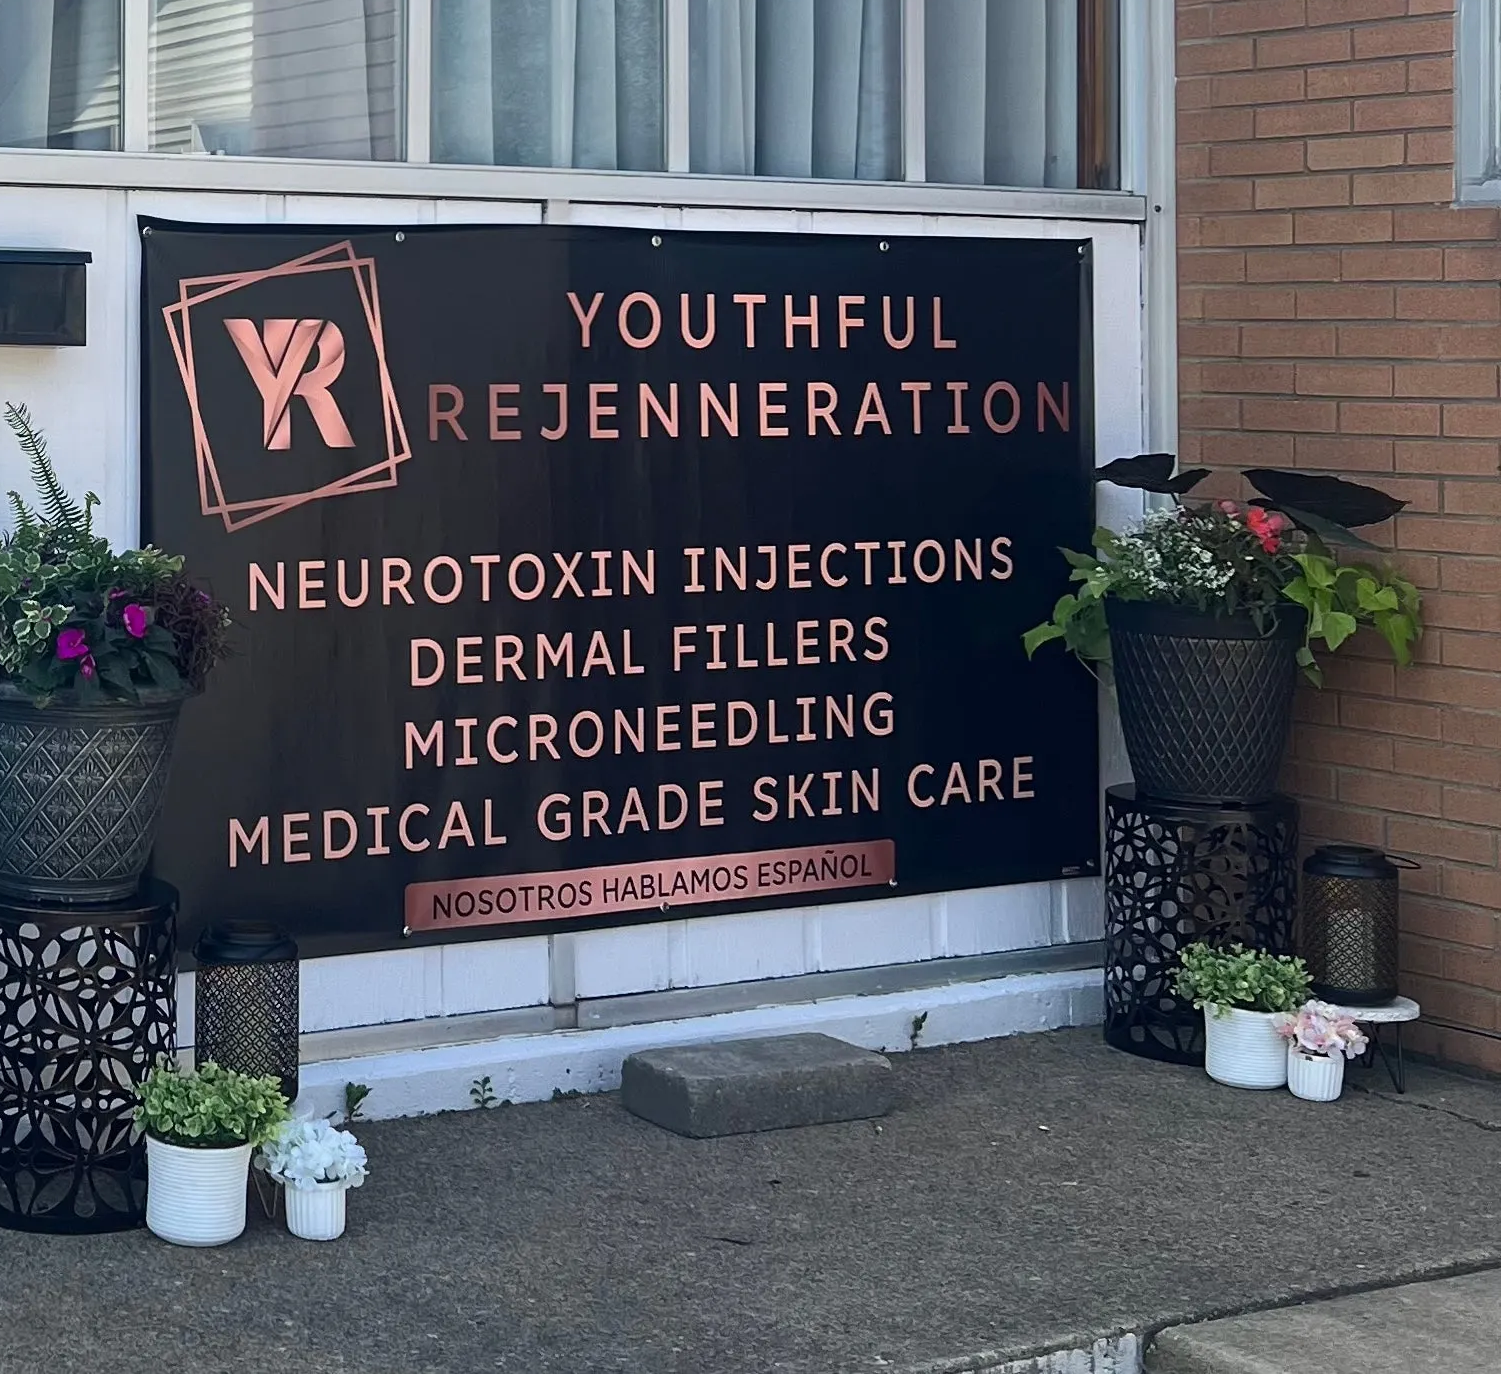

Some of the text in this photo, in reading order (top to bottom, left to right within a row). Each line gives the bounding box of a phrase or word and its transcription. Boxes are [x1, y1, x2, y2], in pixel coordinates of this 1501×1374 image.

[567, 292, 956, 350] YOUTHFUL
[429, 381, 1072, 442] REJENNERATION
[248, 537, 1013, 611] NEUROTOXIN INJECTIONS
[410, 618, 890, 688] DERMAL FILLERS
[405, 692, 894, 769] MICRONEEDLING
[228, 756, 1035, 868] MEDICAL GRADE SKIN CARE
[432, 850, 872, 920] NOSOTROS HABLAMOS ESPAÑOL
